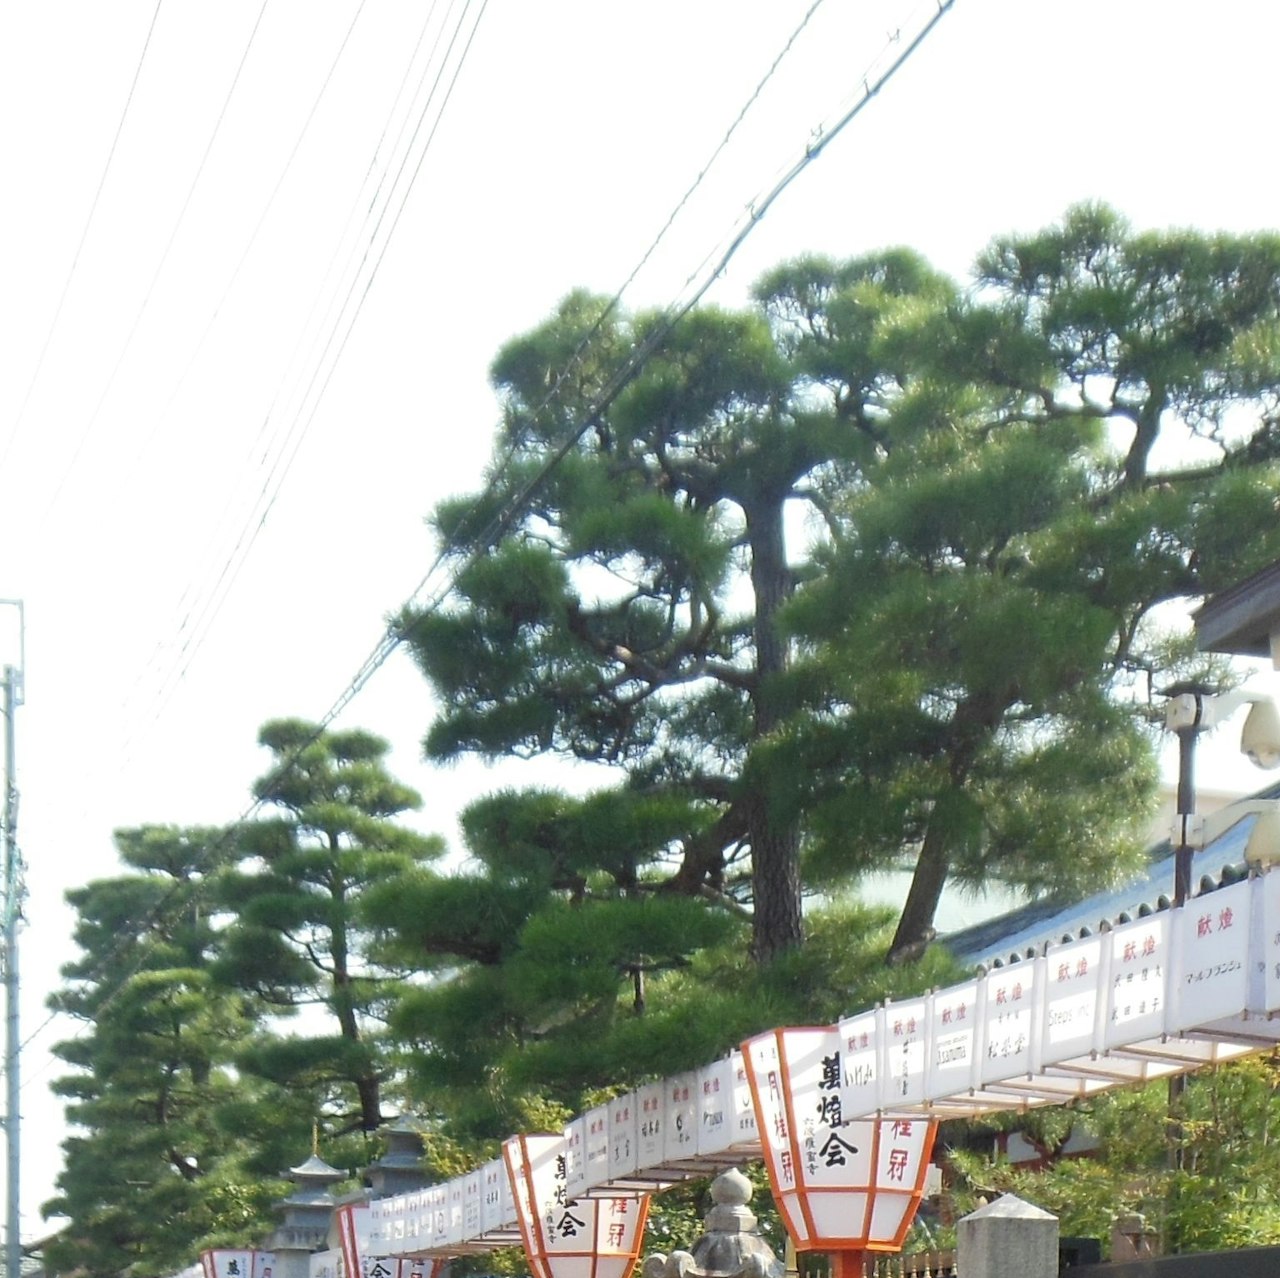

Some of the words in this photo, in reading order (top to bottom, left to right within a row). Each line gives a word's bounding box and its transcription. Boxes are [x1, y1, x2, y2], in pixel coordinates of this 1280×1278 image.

[1197, 907, 1234, 938] 献燈
[1123, 933, 1156, 961] 献燈
[1057, 957, 1087, 983] 献燈
[995, 981, 1023, 1006] 献燈
[941, 1002, 968, 1025] 献燈
